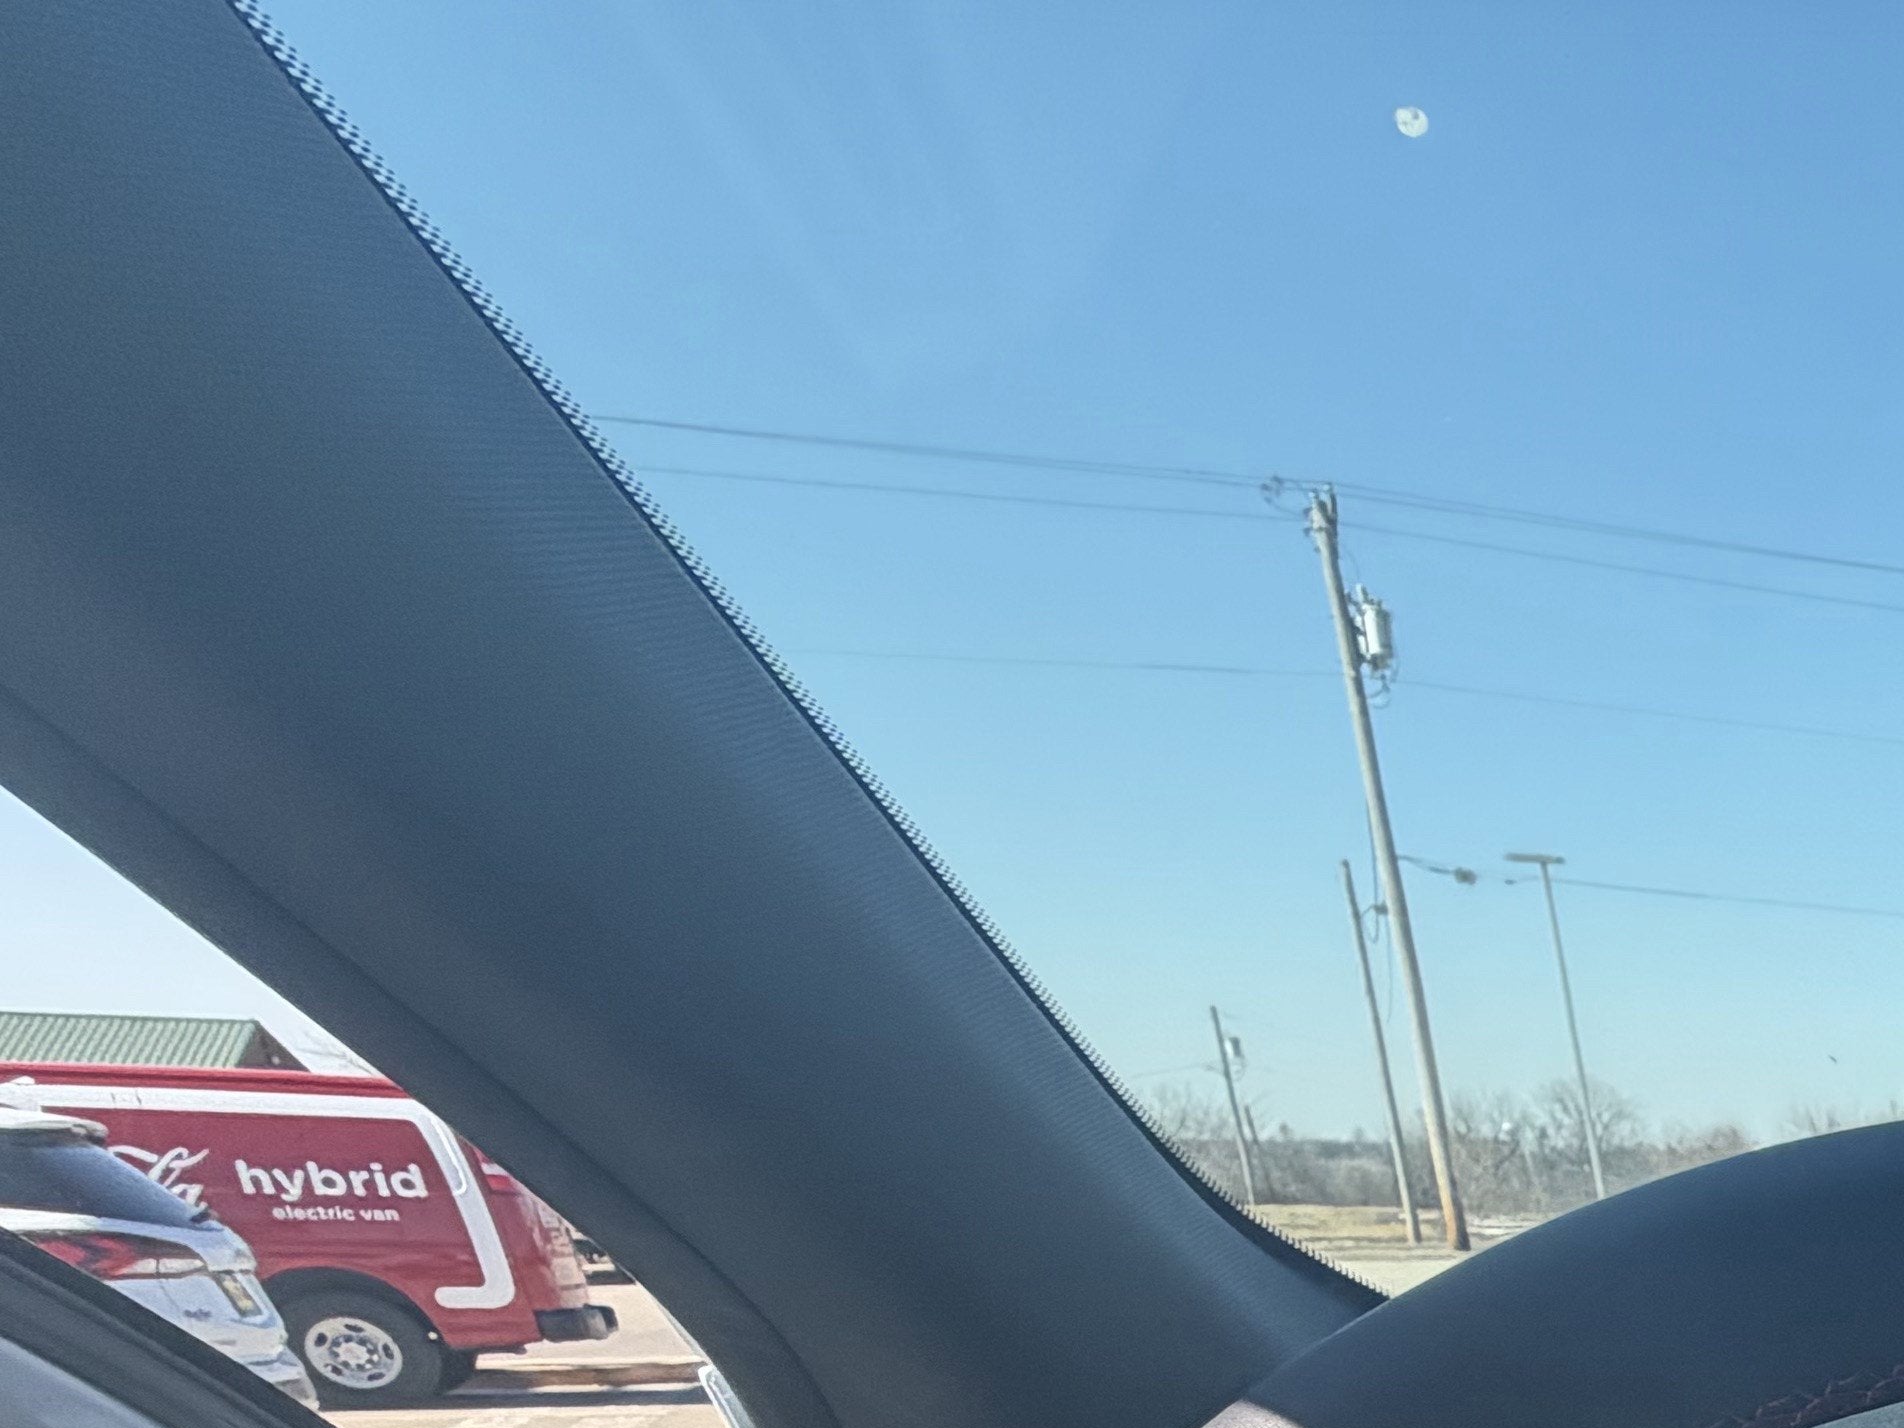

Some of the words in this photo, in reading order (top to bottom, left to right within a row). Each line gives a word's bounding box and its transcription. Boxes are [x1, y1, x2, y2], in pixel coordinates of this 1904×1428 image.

[235, 1159, 428, 1201] hybrid
[272, 1206, 355, 1222] electric
[360, 1208, 400, 1222] van
